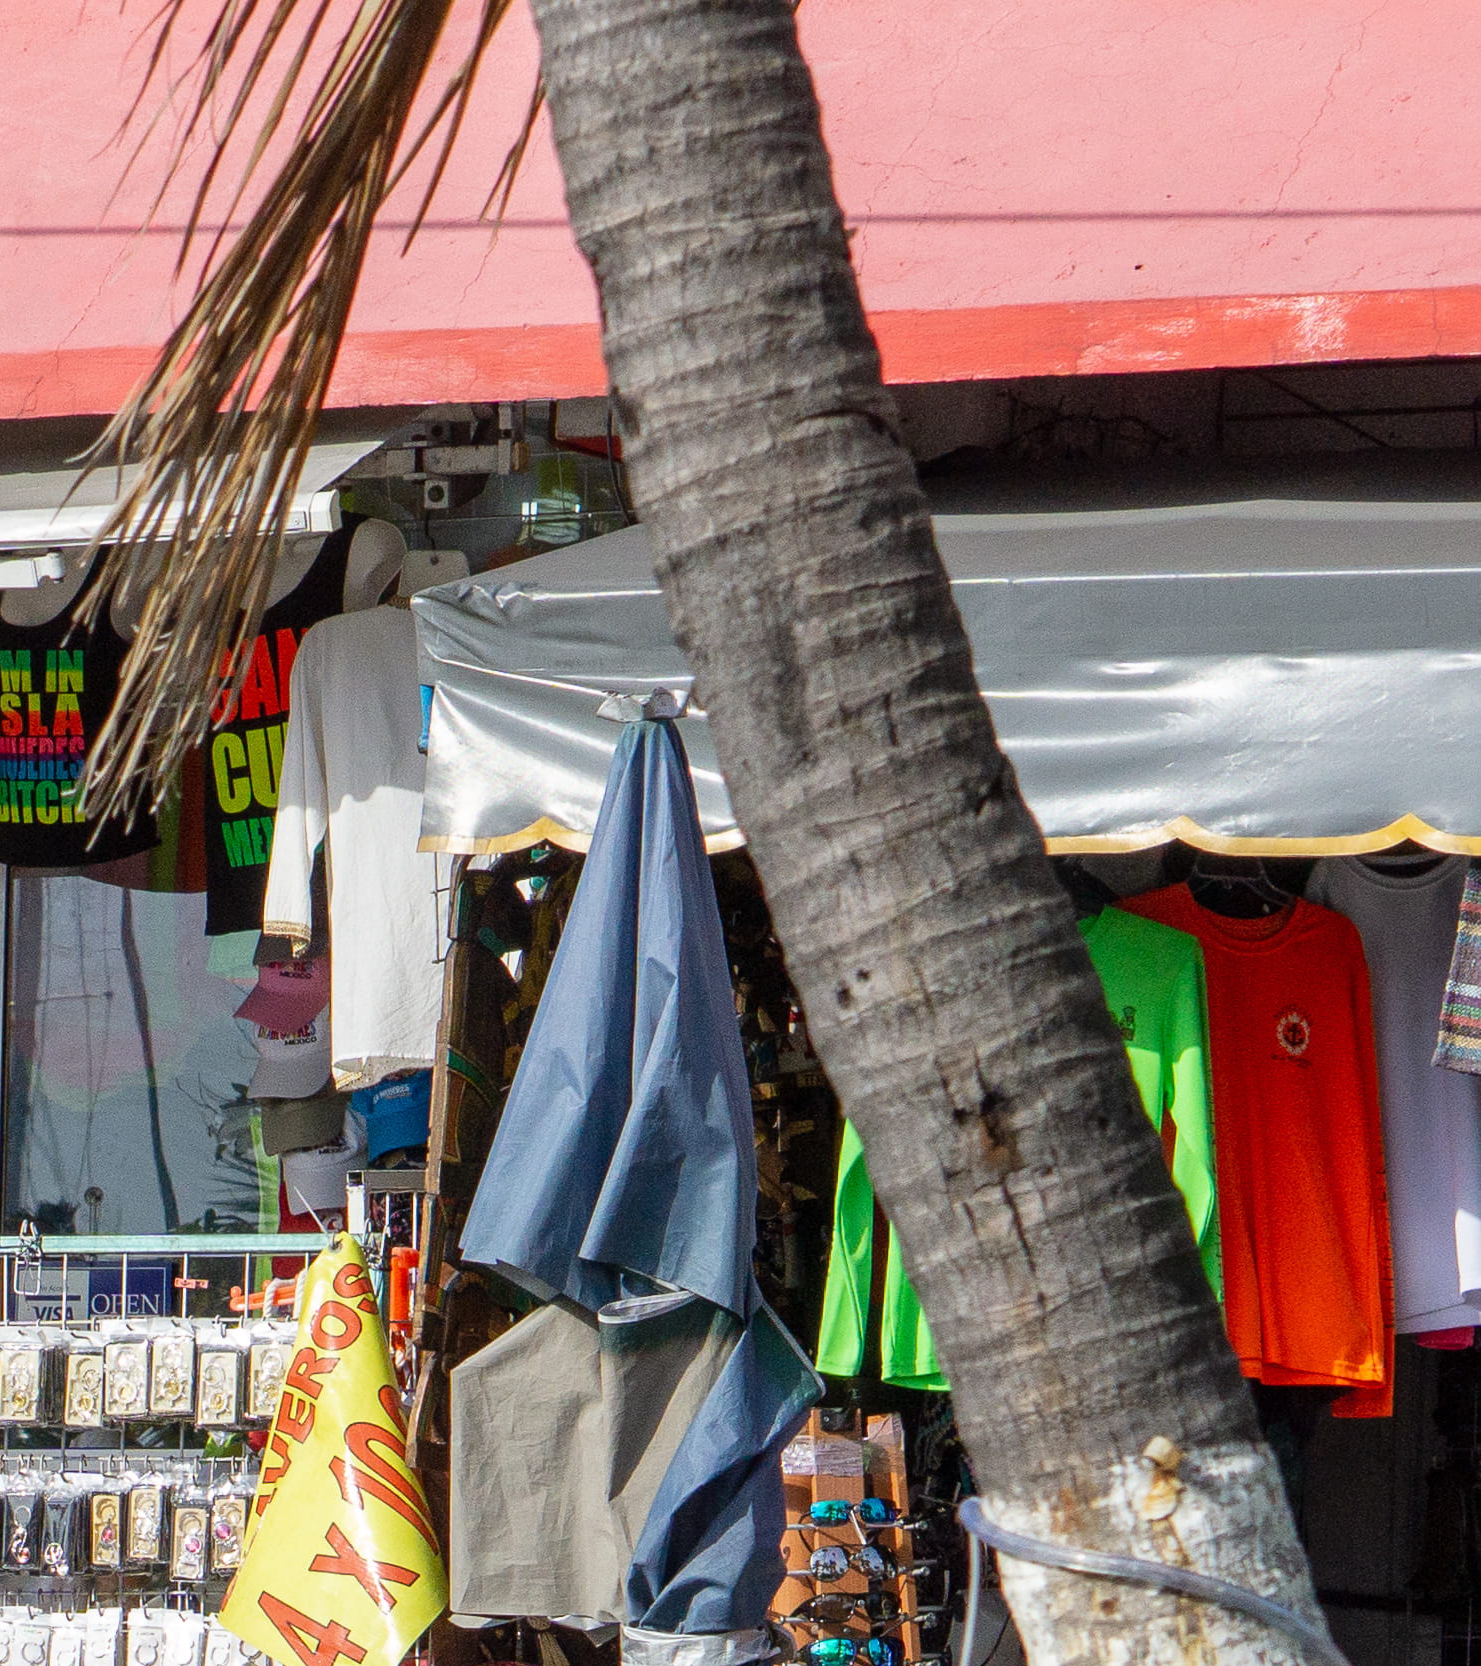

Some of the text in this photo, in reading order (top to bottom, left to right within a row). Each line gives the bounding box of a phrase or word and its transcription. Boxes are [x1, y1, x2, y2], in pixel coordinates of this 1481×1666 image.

[45, 649, 85, 693] IN
[32, 1293, 161, 1321] VISA OPEN
